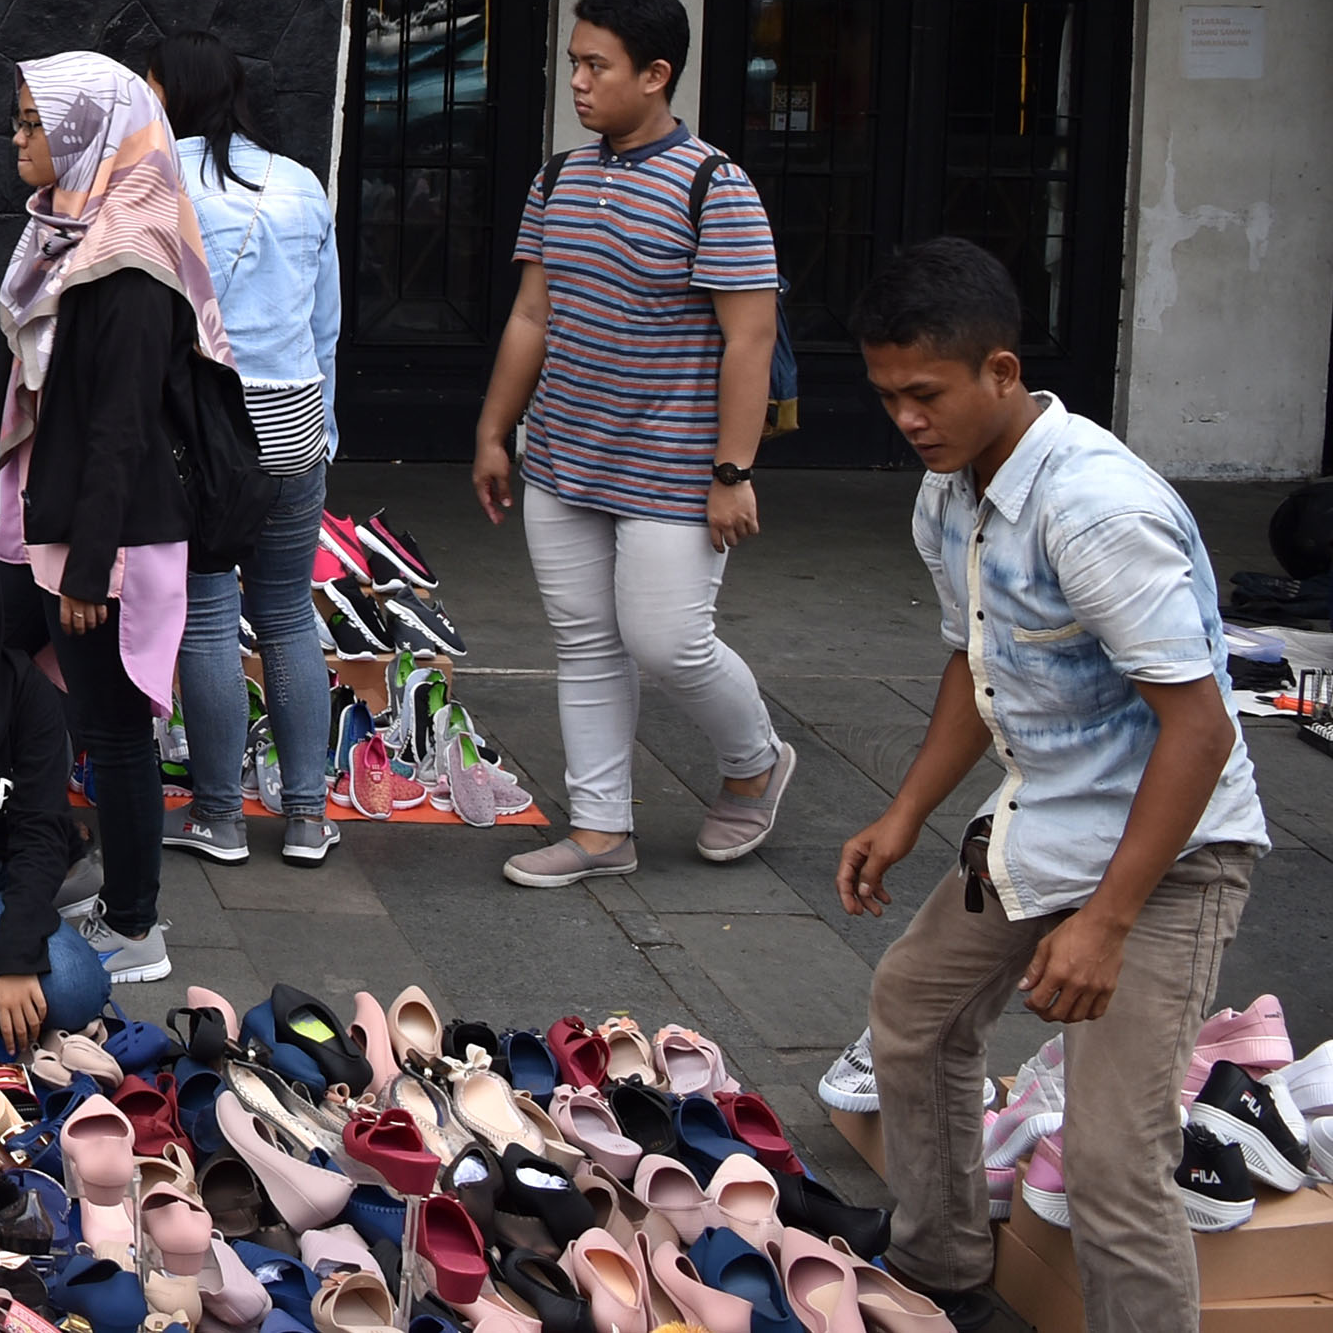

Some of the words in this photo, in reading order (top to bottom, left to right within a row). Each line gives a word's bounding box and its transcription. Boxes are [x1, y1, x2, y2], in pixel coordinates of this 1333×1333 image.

[182, 822, 213, 839] FILA
[1240, 1090, 1262, 1119] FILA
[1190, 1167, 1222, 1184] FILA
